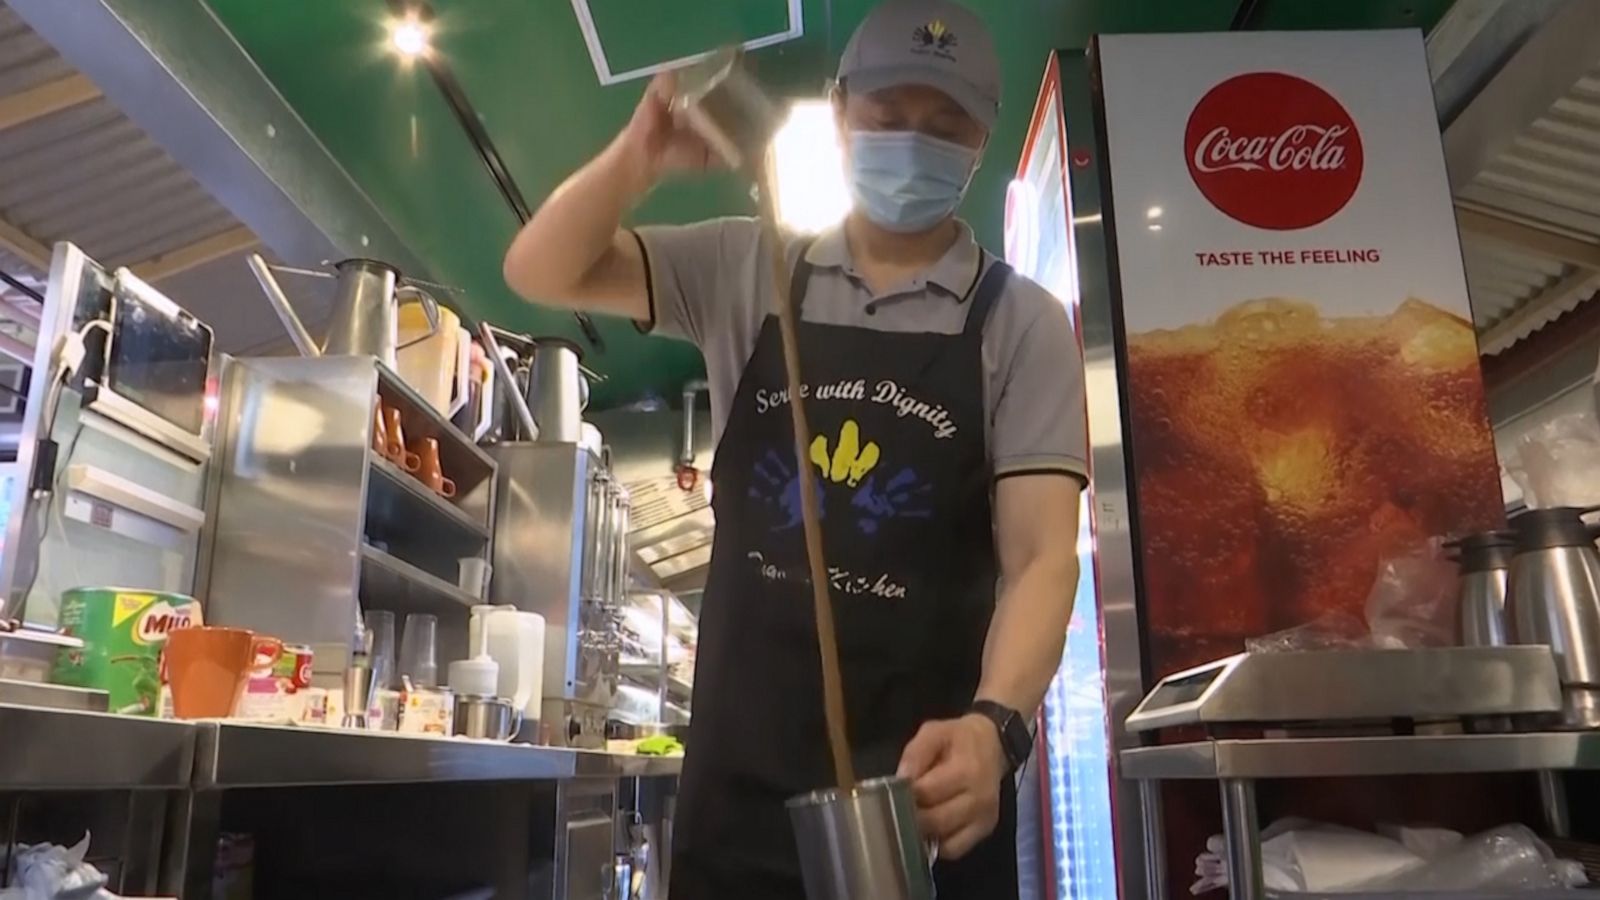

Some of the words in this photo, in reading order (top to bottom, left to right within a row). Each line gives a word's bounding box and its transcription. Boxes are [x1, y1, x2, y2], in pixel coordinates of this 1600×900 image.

[1194, 124, 1350, 173] Coca-Cola
[1195, 252, 1254, 267] TASTE
[1258, 250, 1296, 265] THE
[1300, 249, 1380, 264] FEELING
[815, 379, 866, 400] with
[870, 379, 958, 439] Dignity
